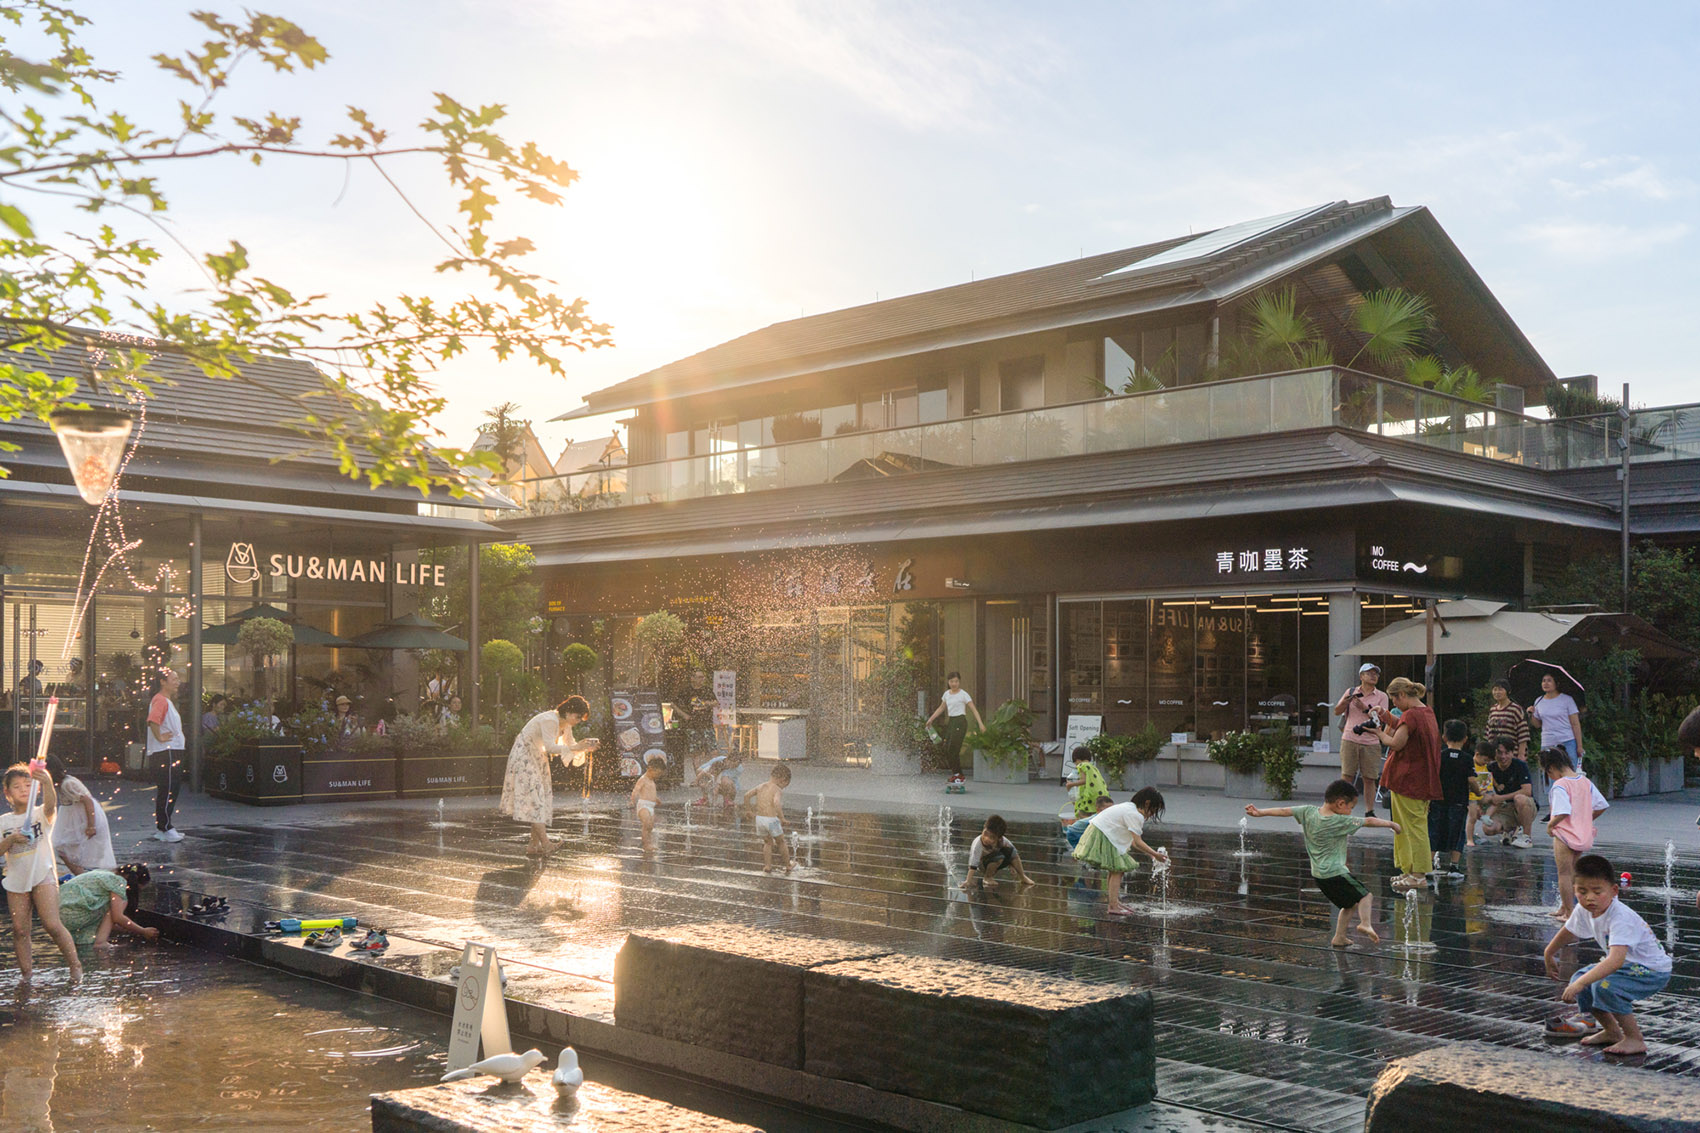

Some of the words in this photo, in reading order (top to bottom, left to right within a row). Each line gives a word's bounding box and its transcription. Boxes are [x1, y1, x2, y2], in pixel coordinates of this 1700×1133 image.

[1216, 547, 1309, 573] 青咖墨茶
[1372, 546, 1384, 557] MO
[269, 553, 385, 583] SU&MAN
[396, 562, 446, 587] LIFE
[1372, 559, 1399, 572] COFFEE
